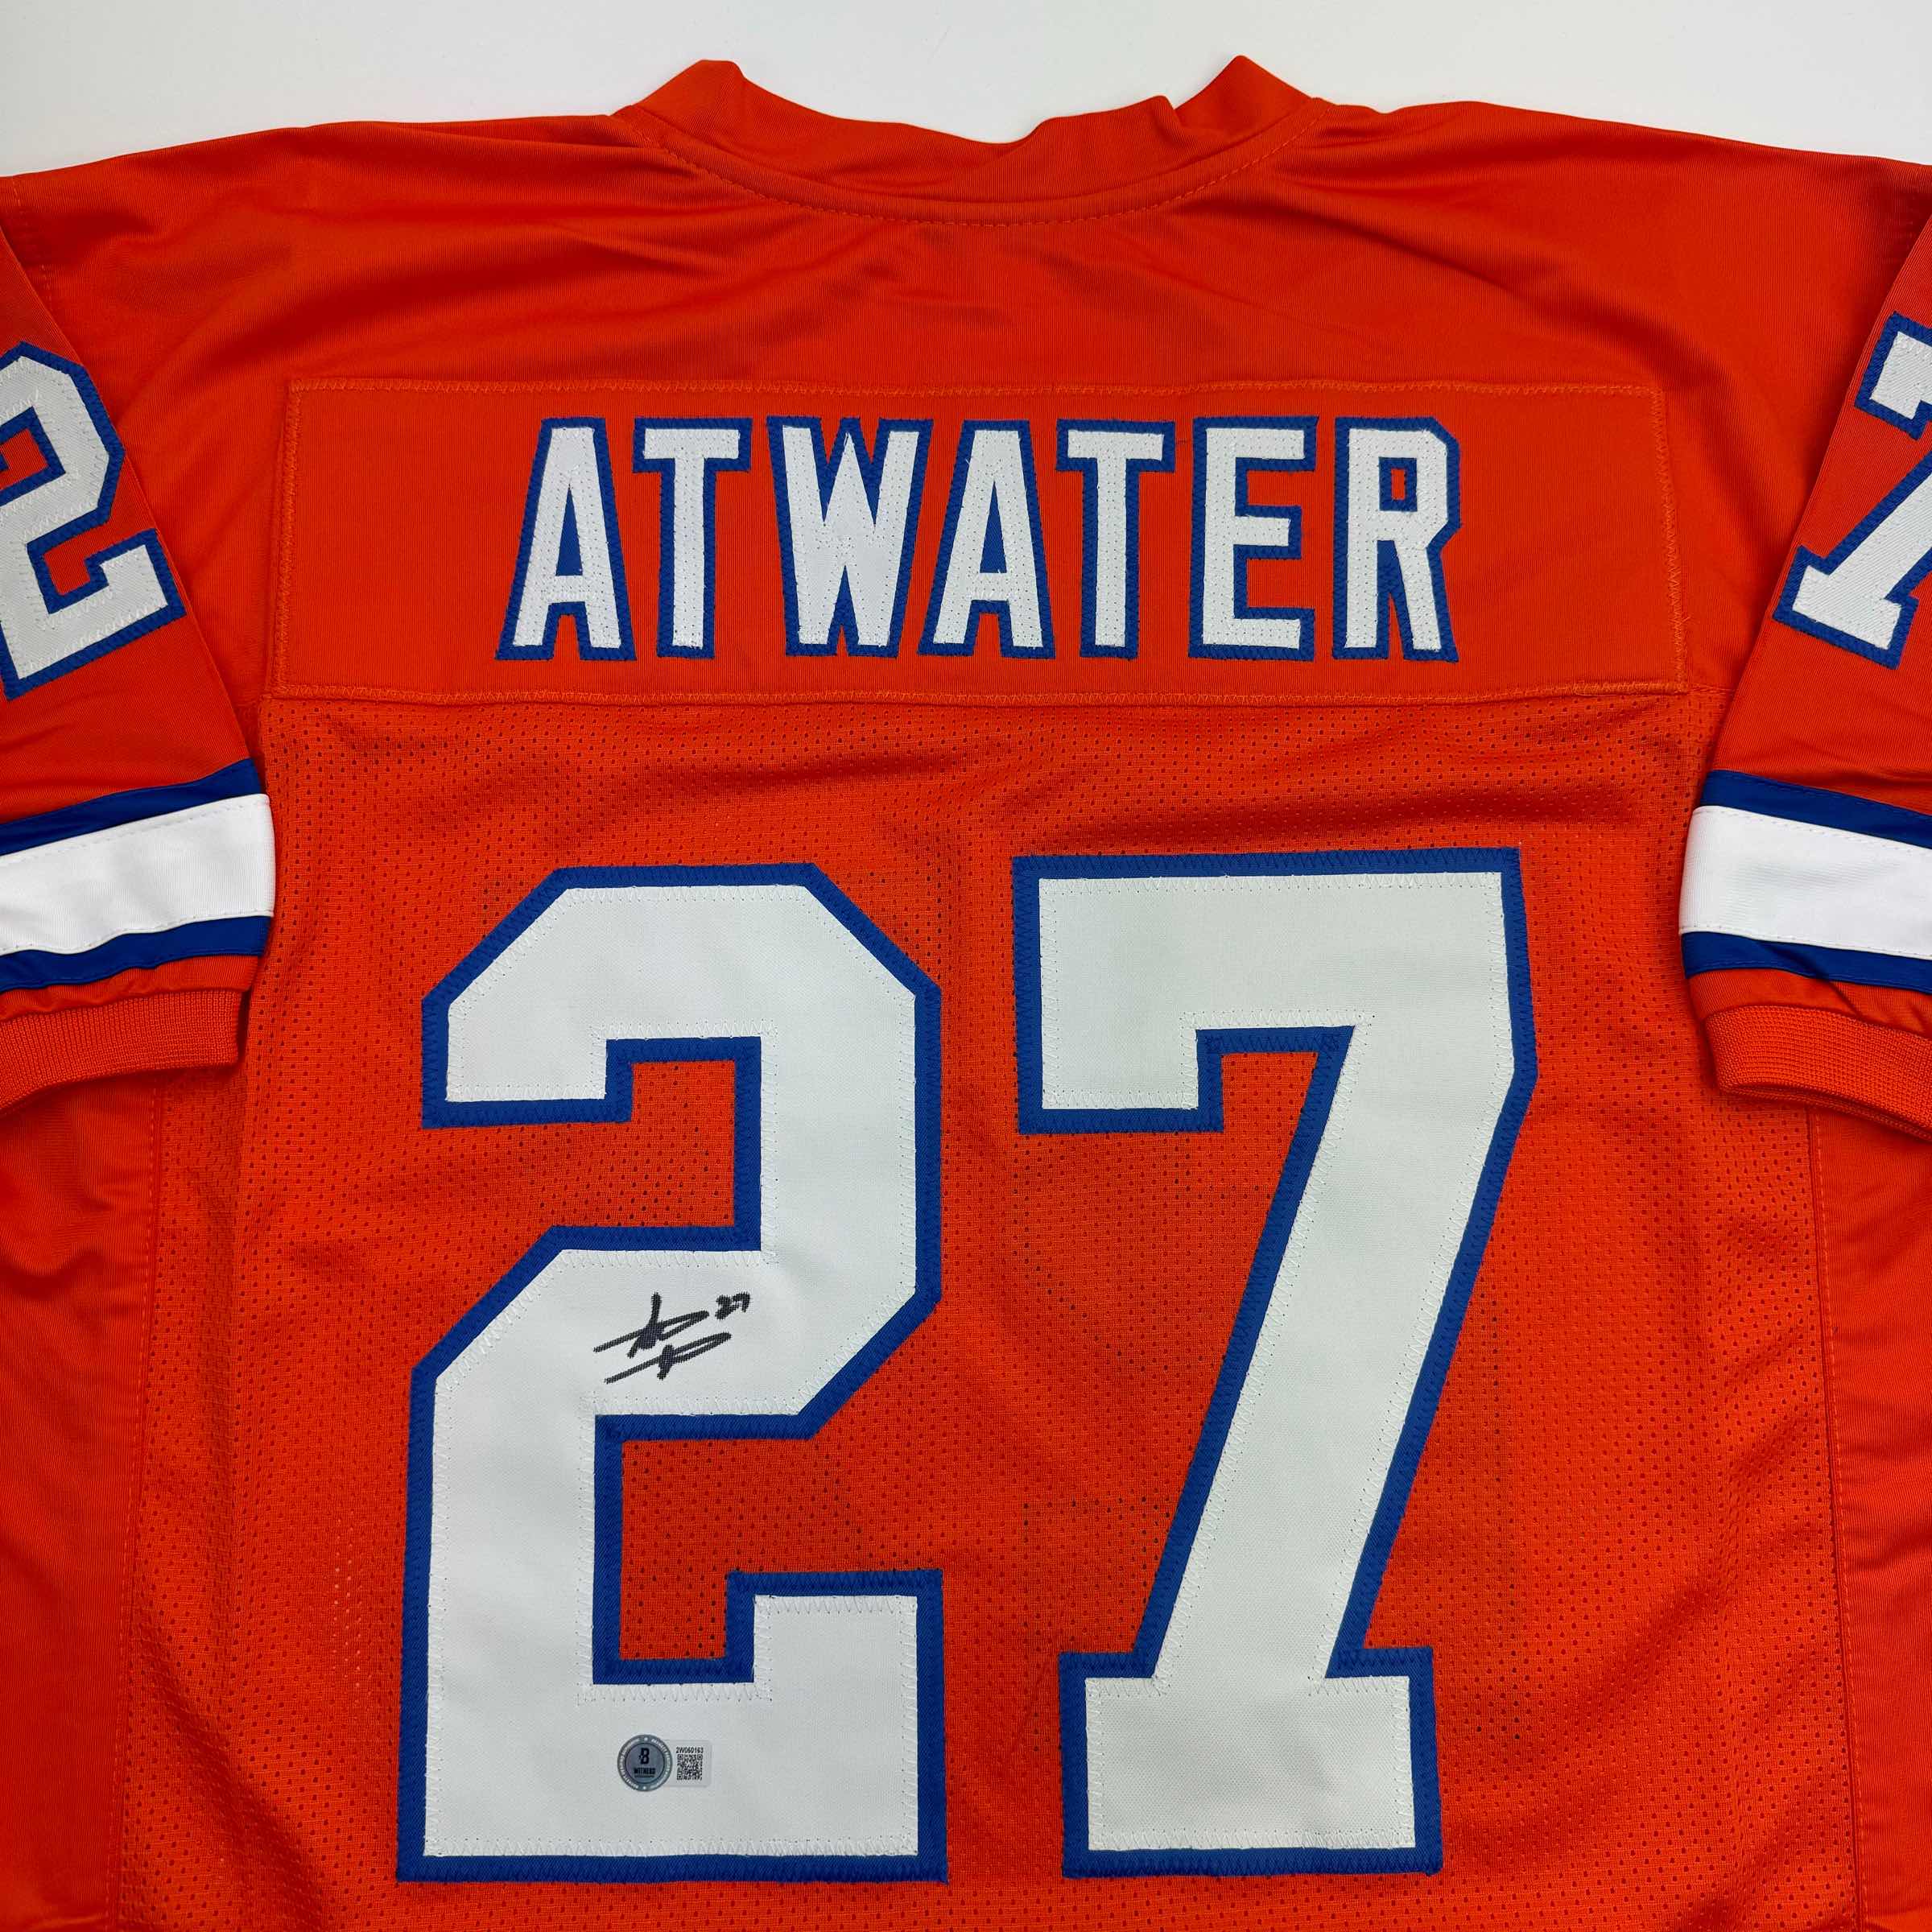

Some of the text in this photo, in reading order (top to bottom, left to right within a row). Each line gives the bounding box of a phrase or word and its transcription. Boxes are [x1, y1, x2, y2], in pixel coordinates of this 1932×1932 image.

[0, 341, 187, 700] 2
[496, 416, 1460, 663] ATWATER
[1773, 311, 1932, 670] 7
[397, 847, 1538, 1883] 27
